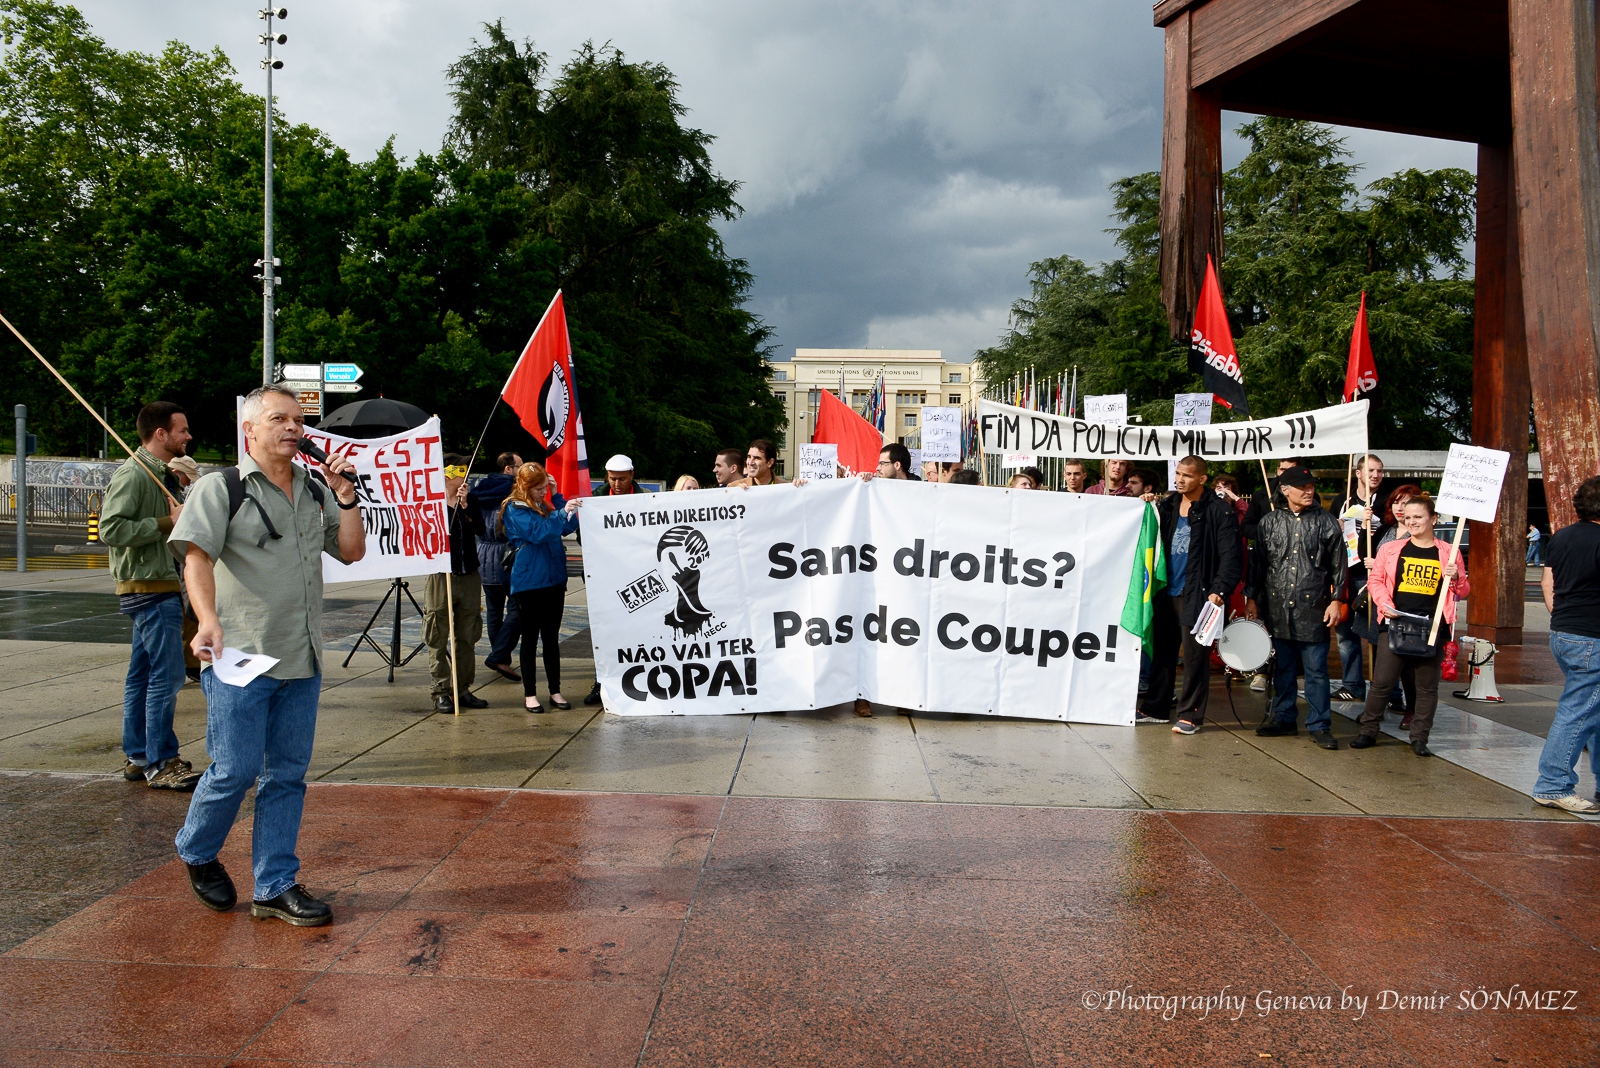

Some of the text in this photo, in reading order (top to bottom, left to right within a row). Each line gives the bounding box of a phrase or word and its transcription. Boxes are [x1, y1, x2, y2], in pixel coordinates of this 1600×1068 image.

[925, 441, 950, 452] FIFA
[1031, 416, 1062, 451] DA
[1172, 426, 1273, 456] MILITAR
[374, 435, 440, 469] EST
[1460, 462, 1478, 473] AOS
[380, 467, 446, 504] AVEC
[603, 504, 746, 529] NÃO TEM DIREITOS?
[379, 506, 400, 556] AU
[687, 550, 711, 569] 2014
[767, 538, 1076, 589] Sans droits?
[1406, 563, 1440, 581] FREE
[619, 575, 662, 604] FIFA
[628, 583, 666, 610] GO HOME
[1405, 577, 1437, 589] ASSANGE
[703, 621, 728, 639] RECC
[773, 604, 1119, 668] Pas de Coupe!
[617, 637, 756, 663] NÃO VAI TER
[621, 657, 758, 702] COPA!
